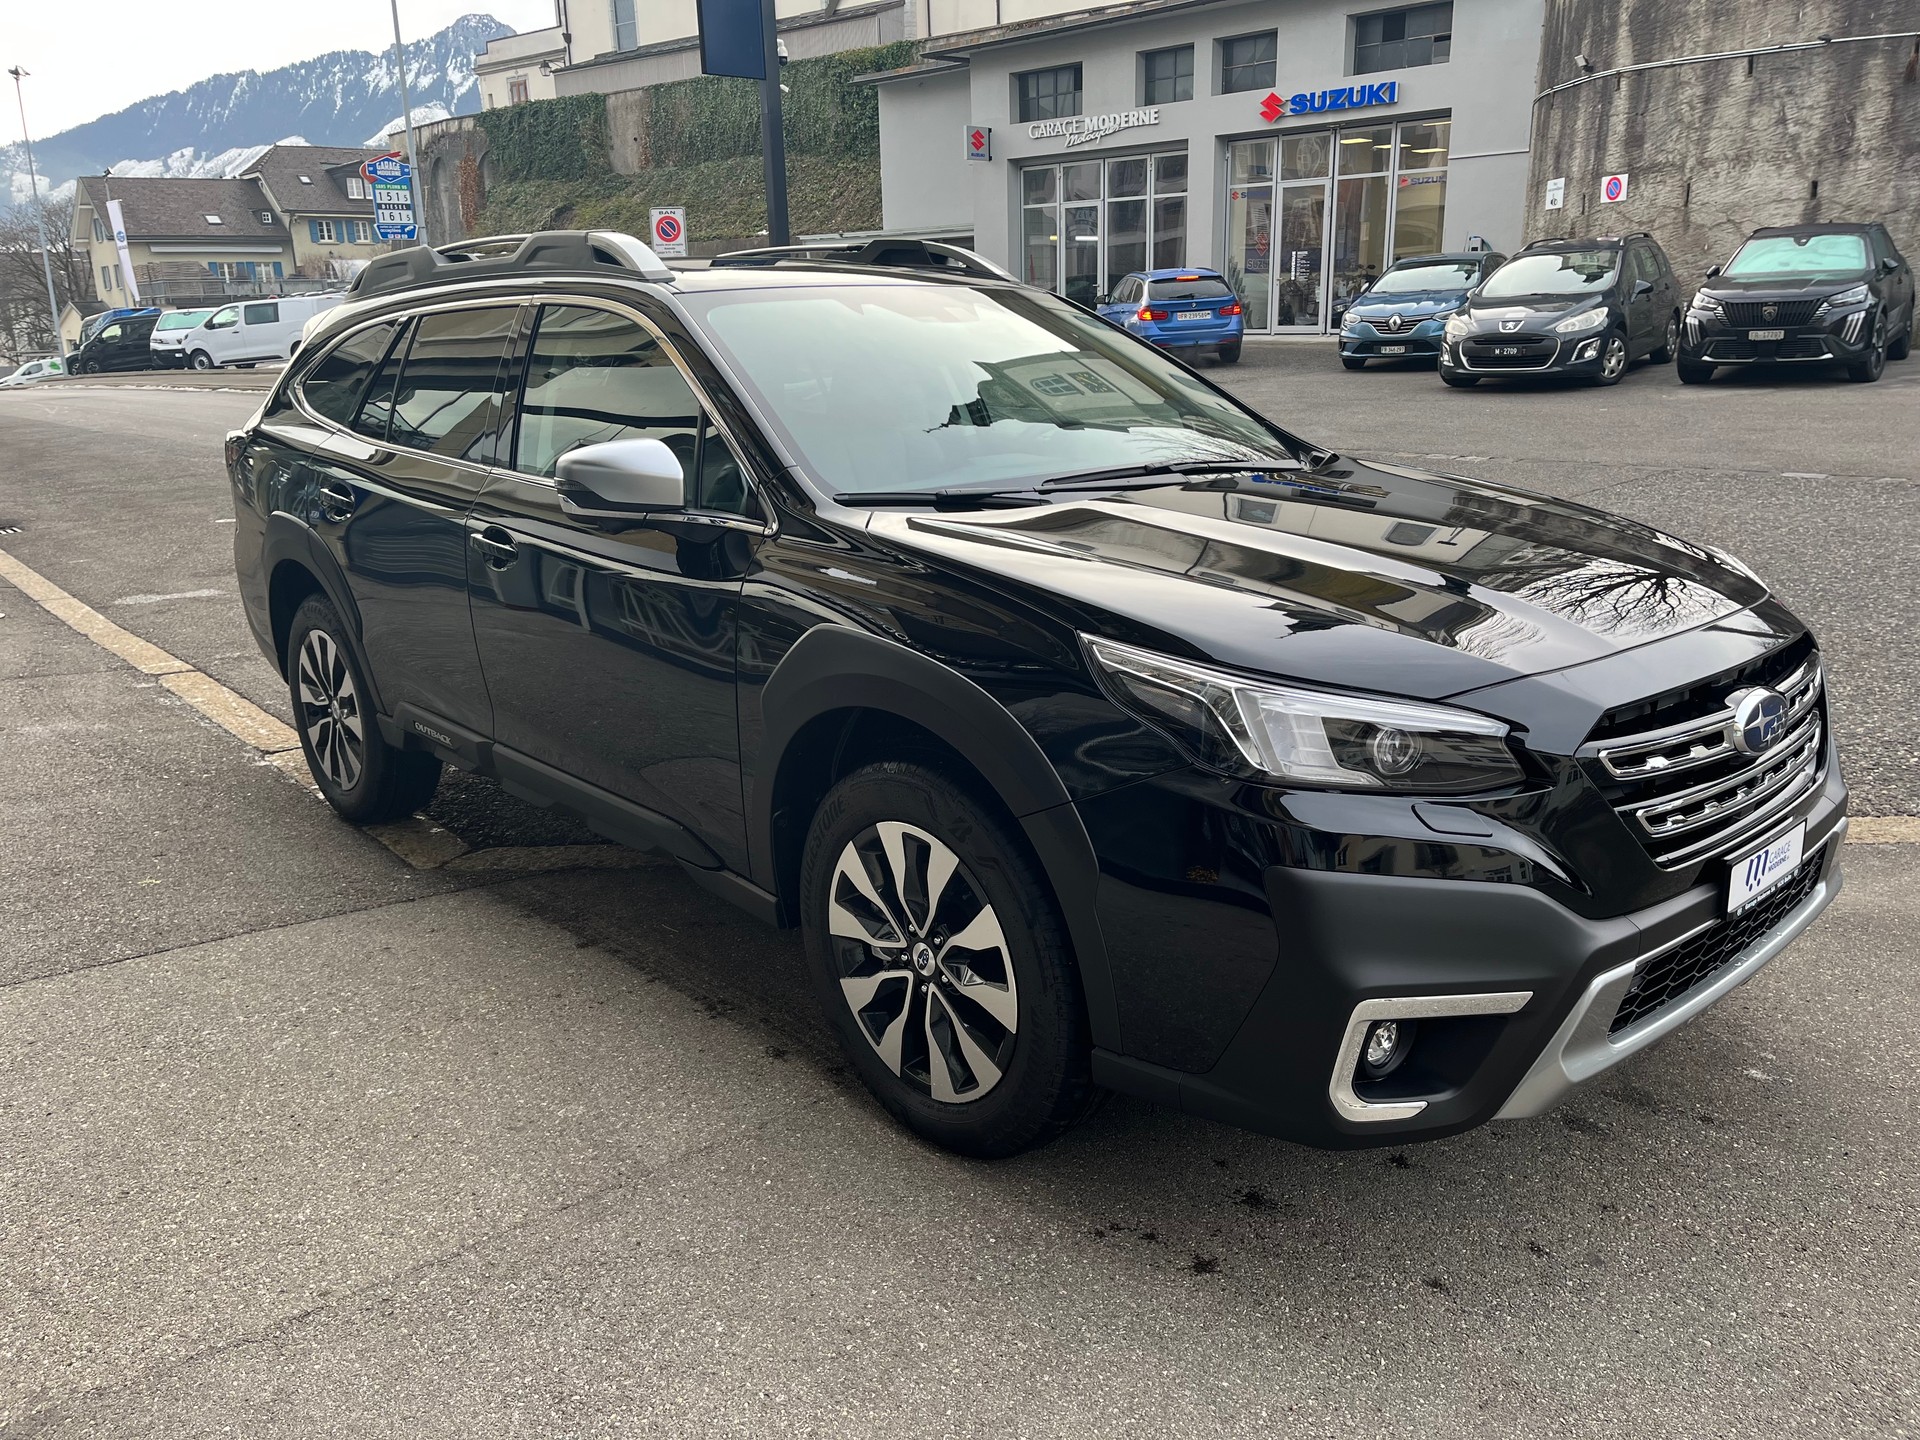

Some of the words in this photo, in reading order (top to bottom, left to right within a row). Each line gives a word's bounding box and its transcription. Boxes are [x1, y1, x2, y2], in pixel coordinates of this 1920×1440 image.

[1289, 81, 1398, 115] SUZUKI
[1028, 118, 1079, 139] GARAGE
[1084, 108, 1160, 132] MODERNE
[376, 161, 401, 171] GARAGE
[414, 721, 453, 746] OUTBACK
[1769, 840, 1791, 864] GARAGE
